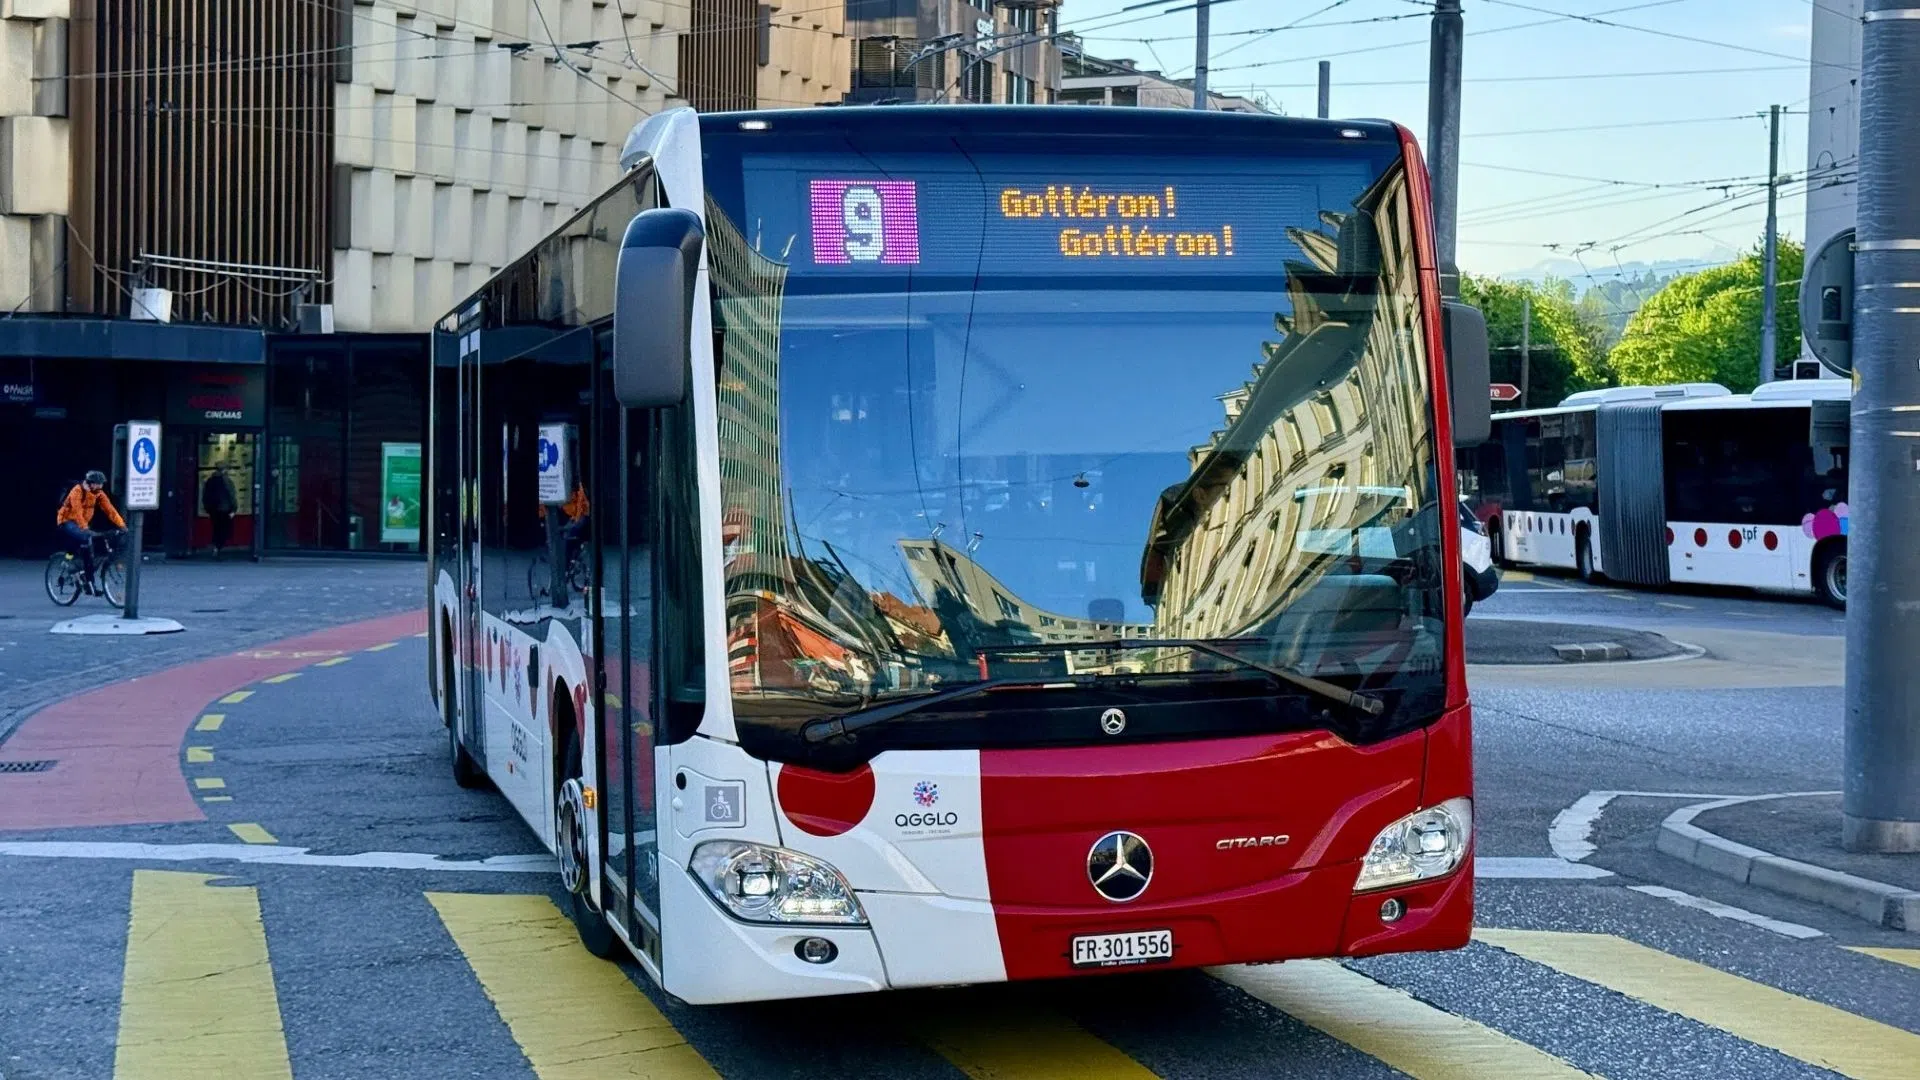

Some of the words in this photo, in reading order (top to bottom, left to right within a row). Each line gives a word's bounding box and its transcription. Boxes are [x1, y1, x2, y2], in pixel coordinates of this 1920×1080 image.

[1001, 186, 1175, 217] Gottéron!
[844, 189, 883, 260] 9
[1060, 225, 1233, 256] Gottéron!
[1742, 526, 1758, 543] tpf
[1216, 834, 1290, 850] CITARO
